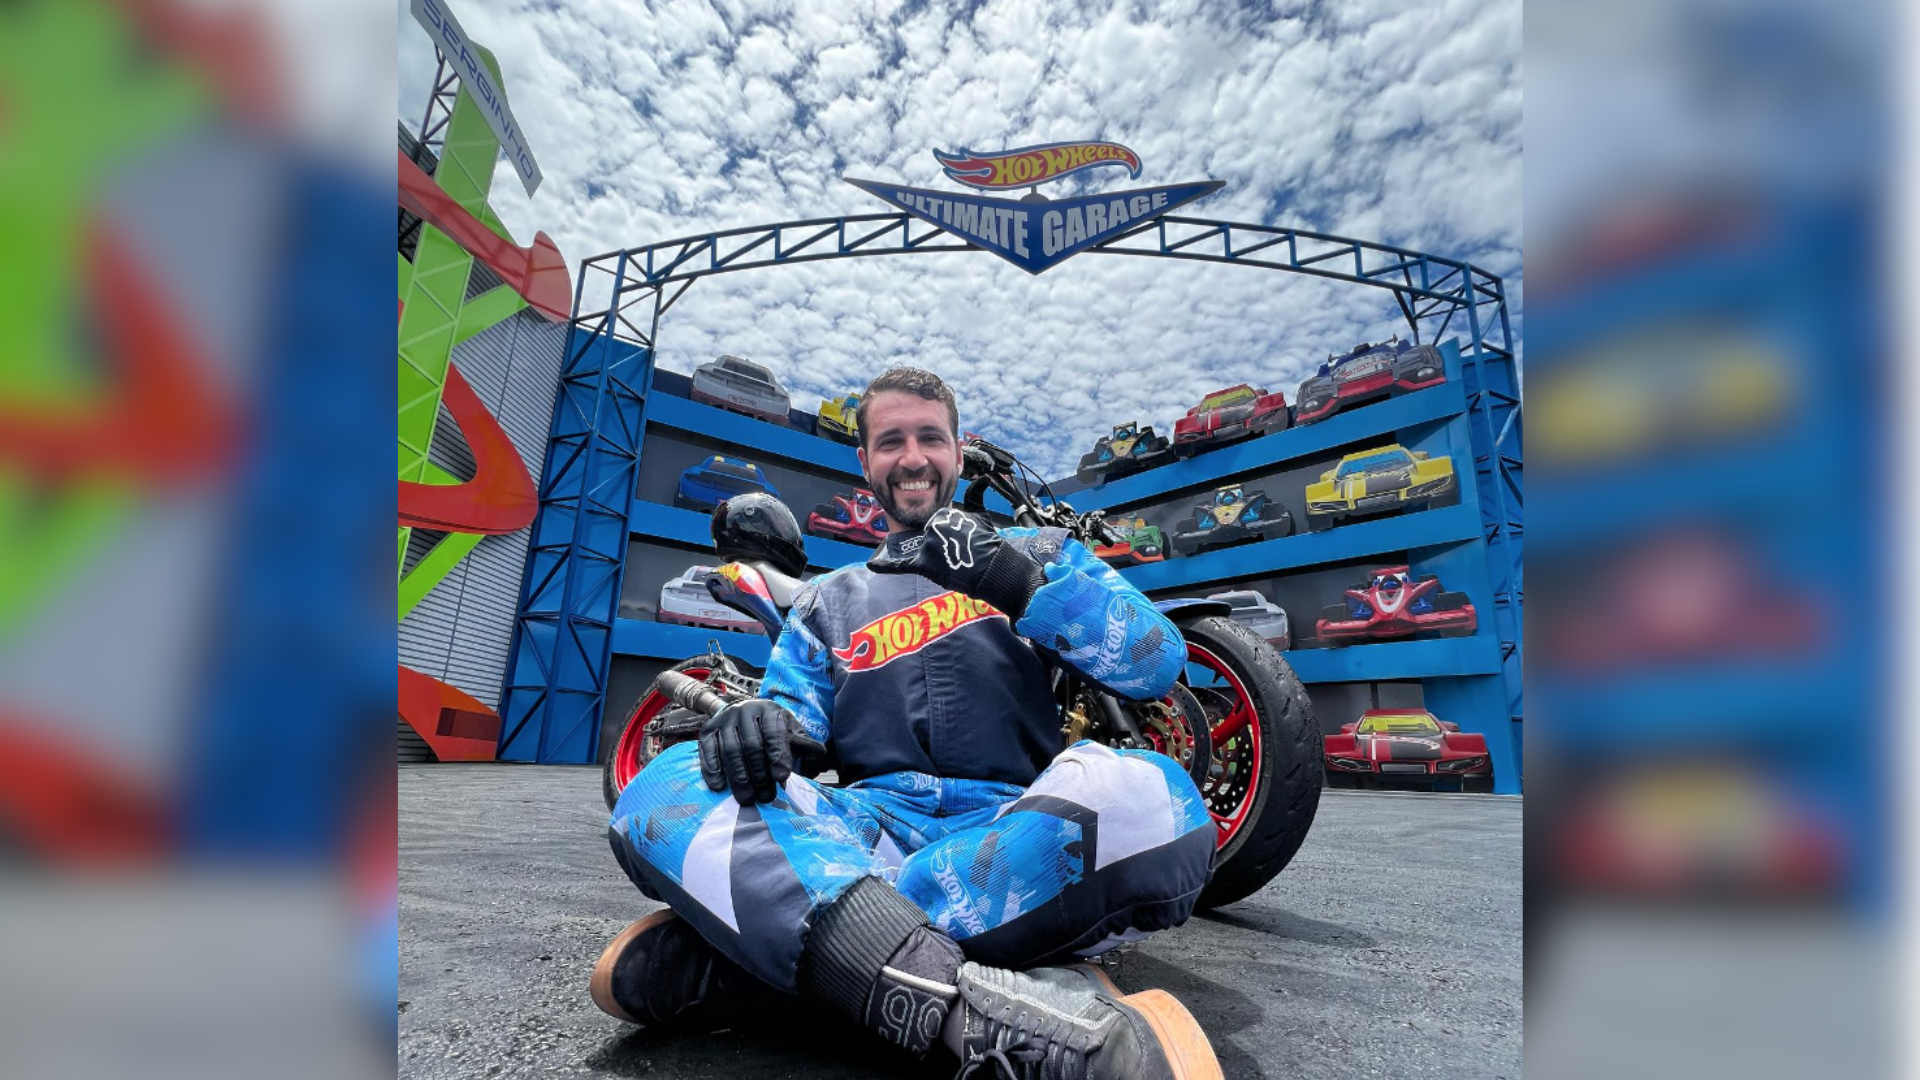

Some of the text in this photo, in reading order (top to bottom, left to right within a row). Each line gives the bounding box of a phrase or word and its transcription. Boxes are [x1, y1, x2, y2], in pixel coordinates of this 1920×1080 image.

[423, 0, 534, 179] SERGINHO
[989, 156, 1044, 184] HOT
[896, 192, 1168, 259] ULTIMATE GARAGE
[862, 613, 925, 665] HOT
